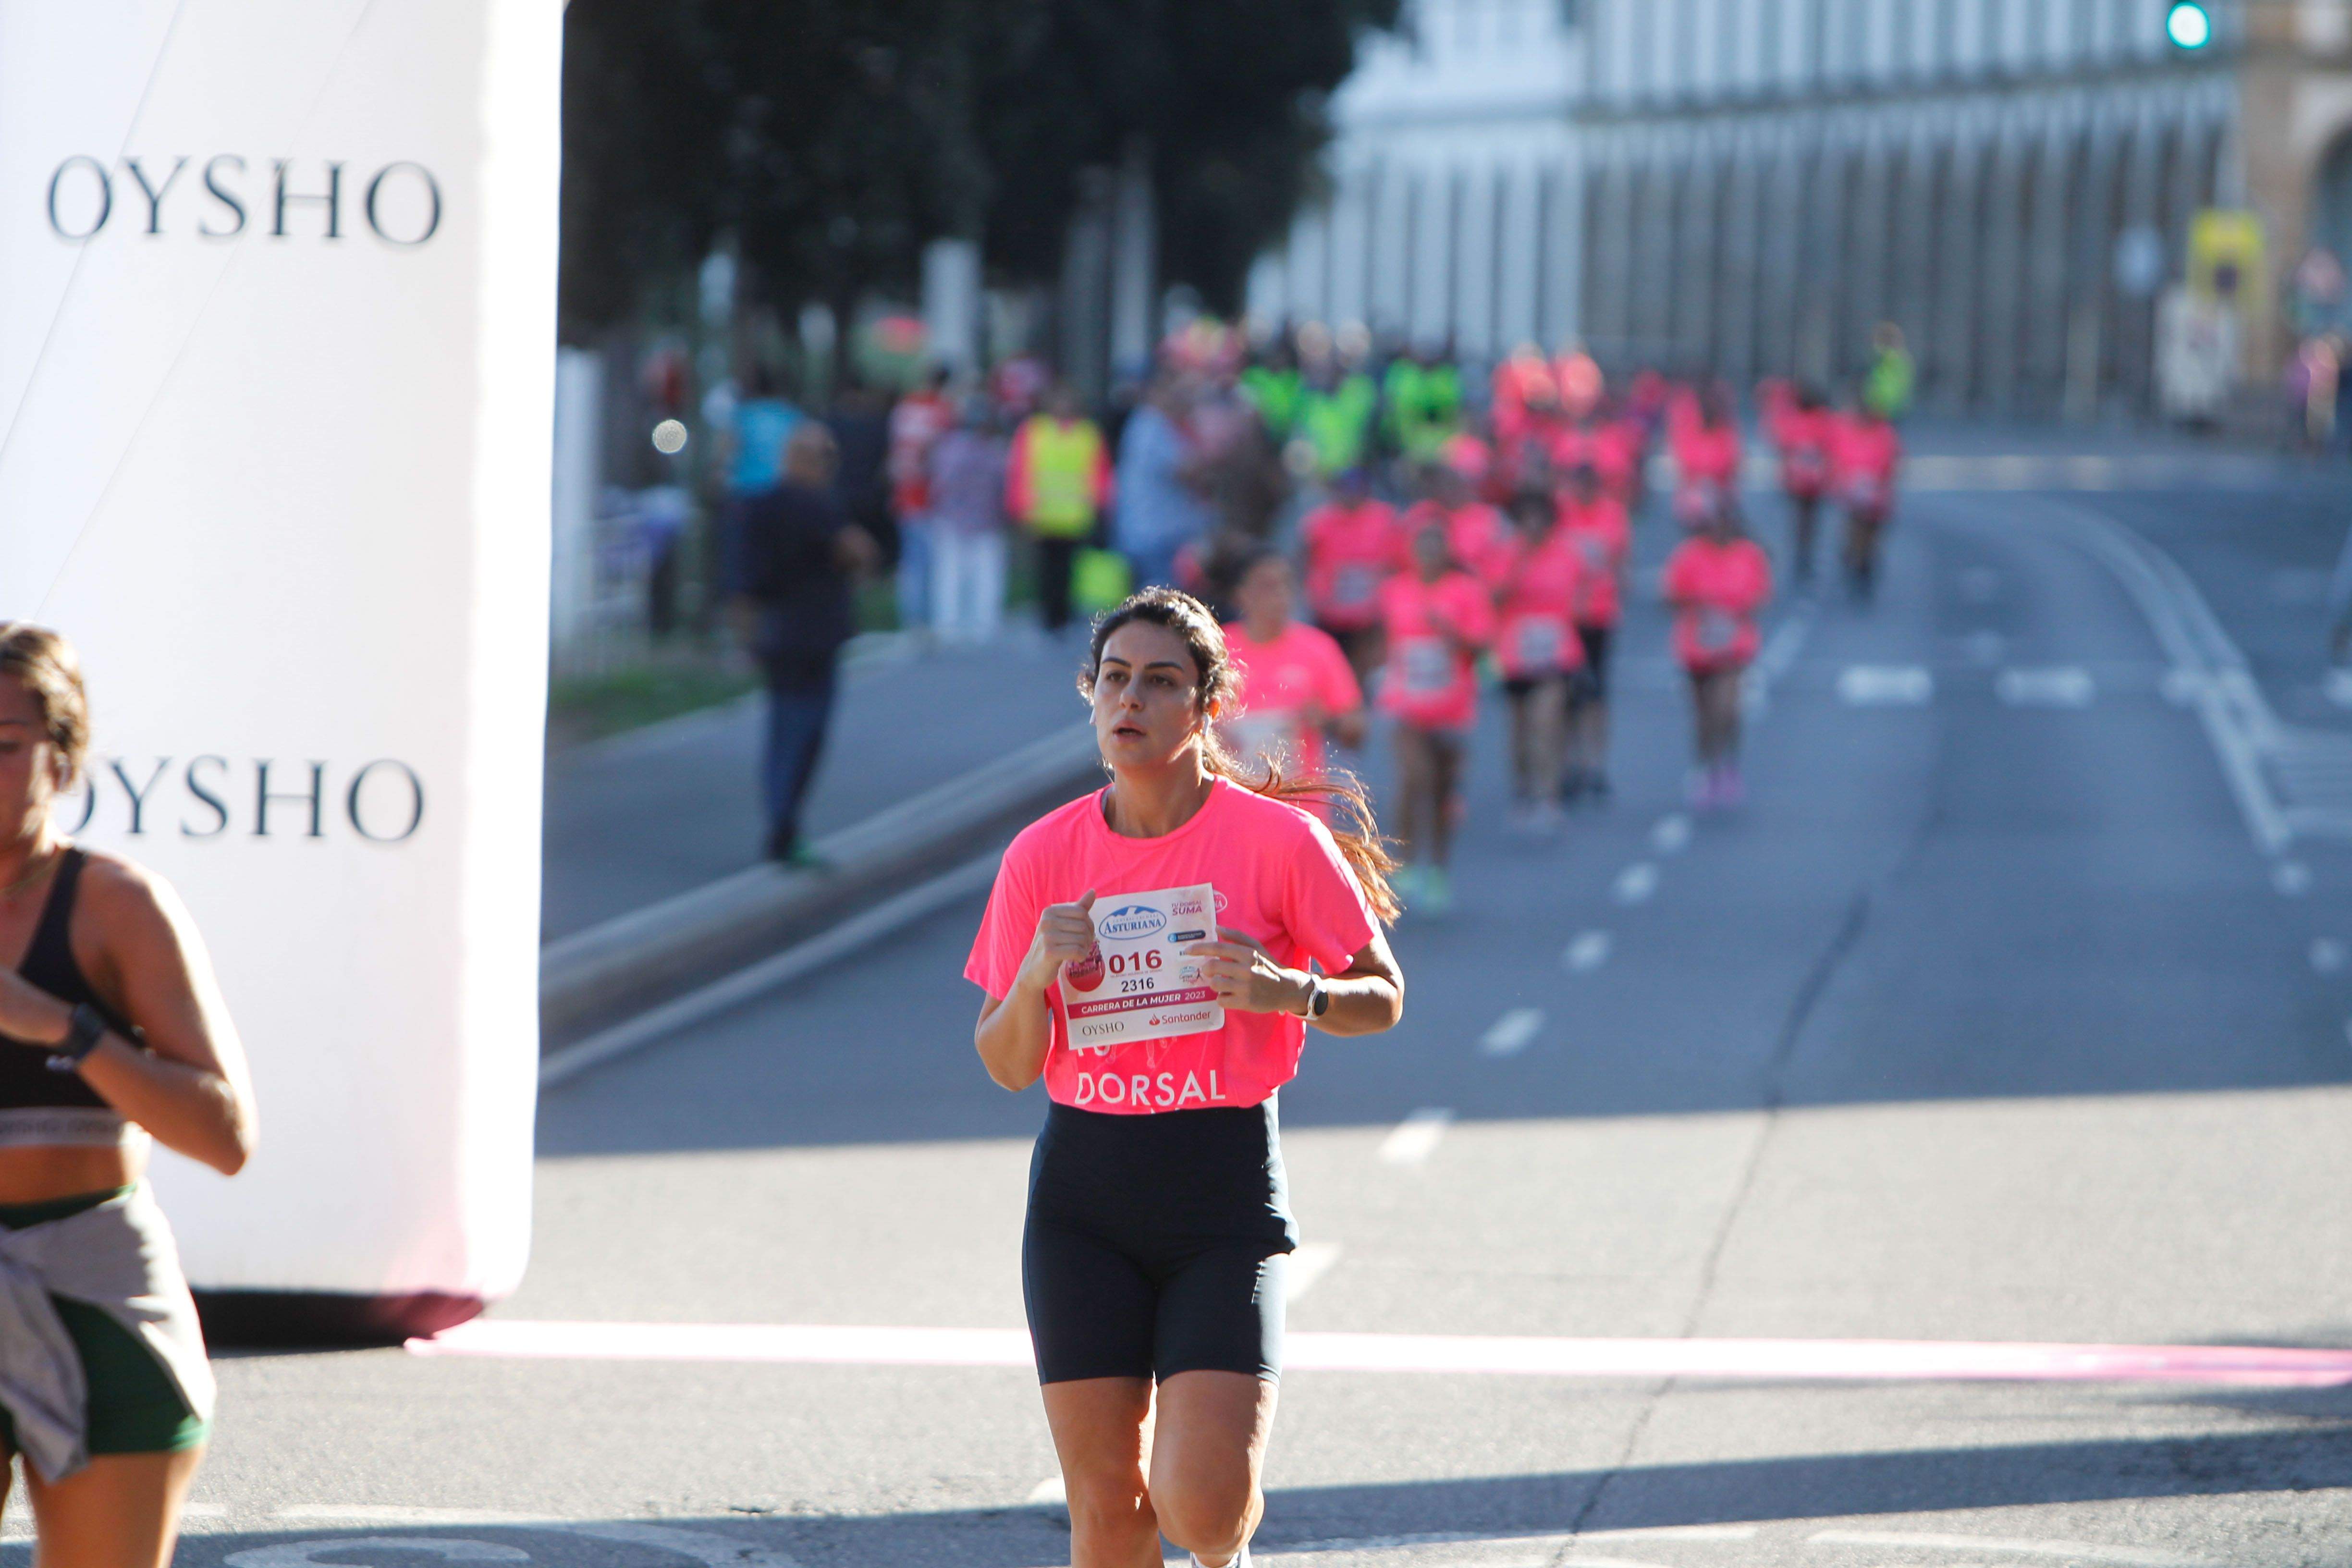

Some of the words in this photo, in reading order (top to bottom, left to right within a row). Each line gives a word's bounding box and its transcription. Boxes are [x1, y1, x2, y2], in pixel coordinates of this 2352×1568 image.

[47, 154, 442, 245] OYSHO
[1172, 906, 1202, 916] SUMA
[1109, 949, 1162, 974] 016
[1121, 977, 1154, 992] 2316
[1081, 1002, 1120, 1013] CARRERA
[1123, 999, 1134, 1008] DE
[1137, 997, 1148, 1006] LA
[1150, 993, 1181, 1004] MUJER
[1185, 991, 1205, 1000] 2023
[1162, 1011, 1211, 1024] Santander
[1082, 1021, 1124, 1036] OYSHO
[1075, 1069, 1225, 1106] DORSAL
